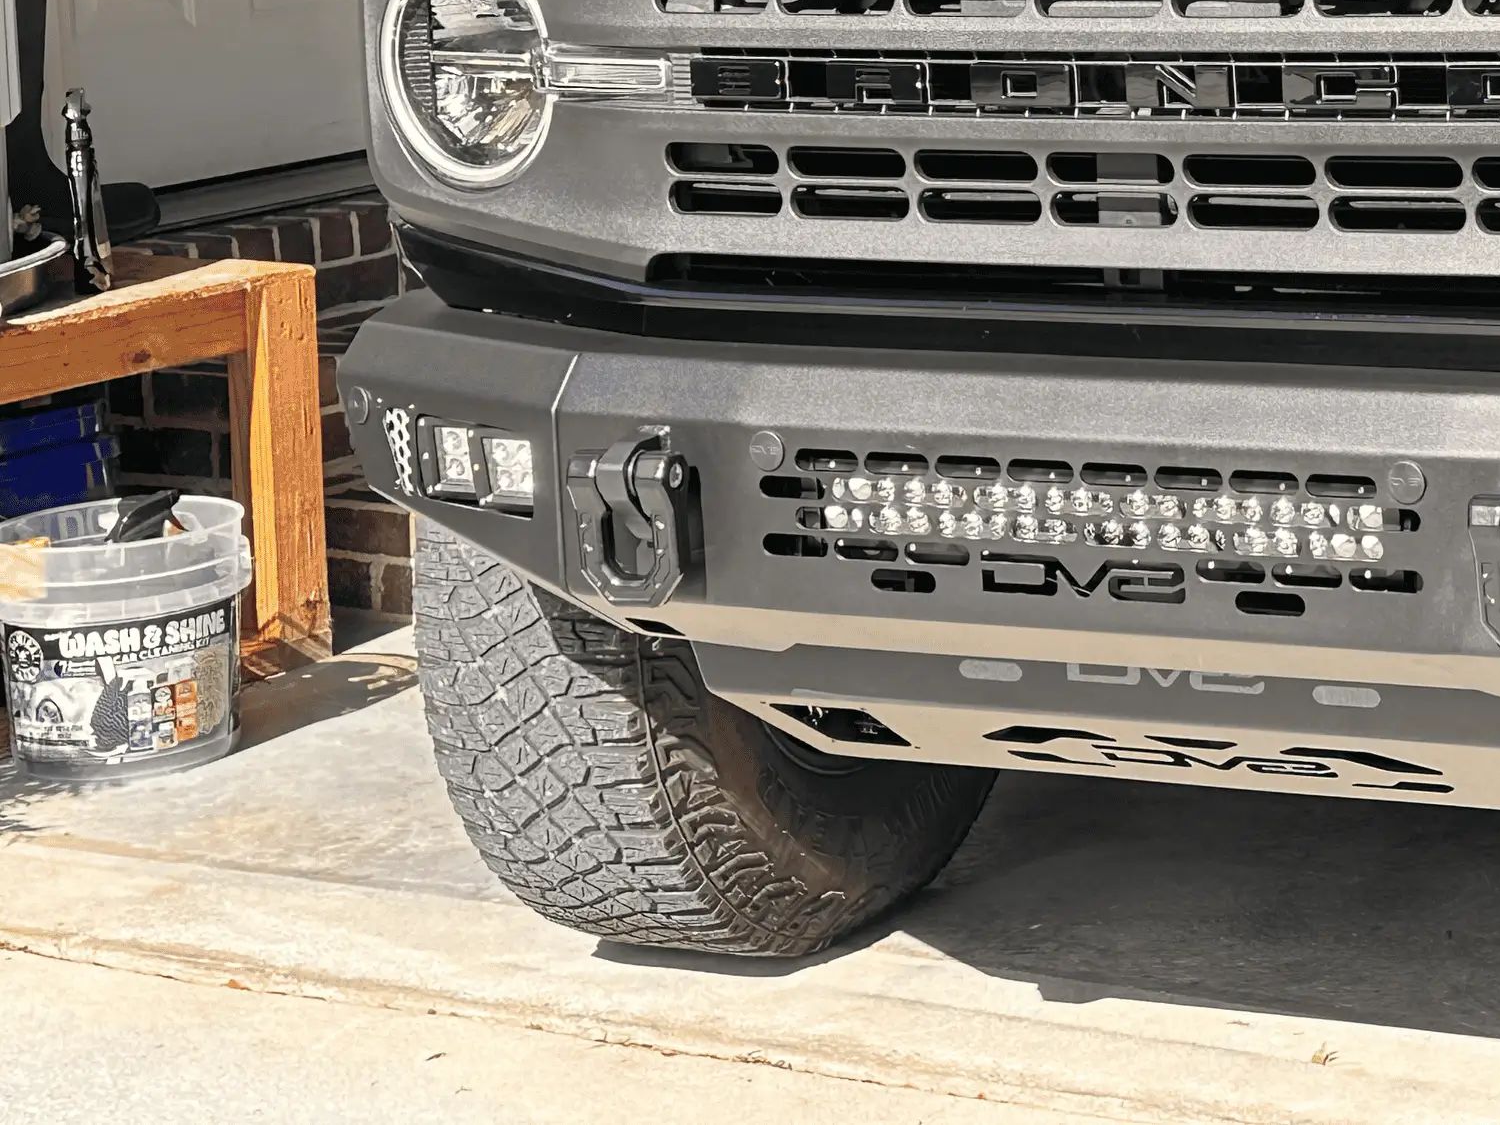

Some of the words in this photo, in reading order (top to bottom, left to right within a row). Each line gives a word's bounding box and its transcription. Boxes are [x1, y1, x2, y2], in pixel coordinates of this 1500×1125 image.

[981, 551, 1187, 604] DV8
[45, 627, 141, 659] WASH
[143, 625, 162, 649] &
[165, 609, 226, 645] SHINE
